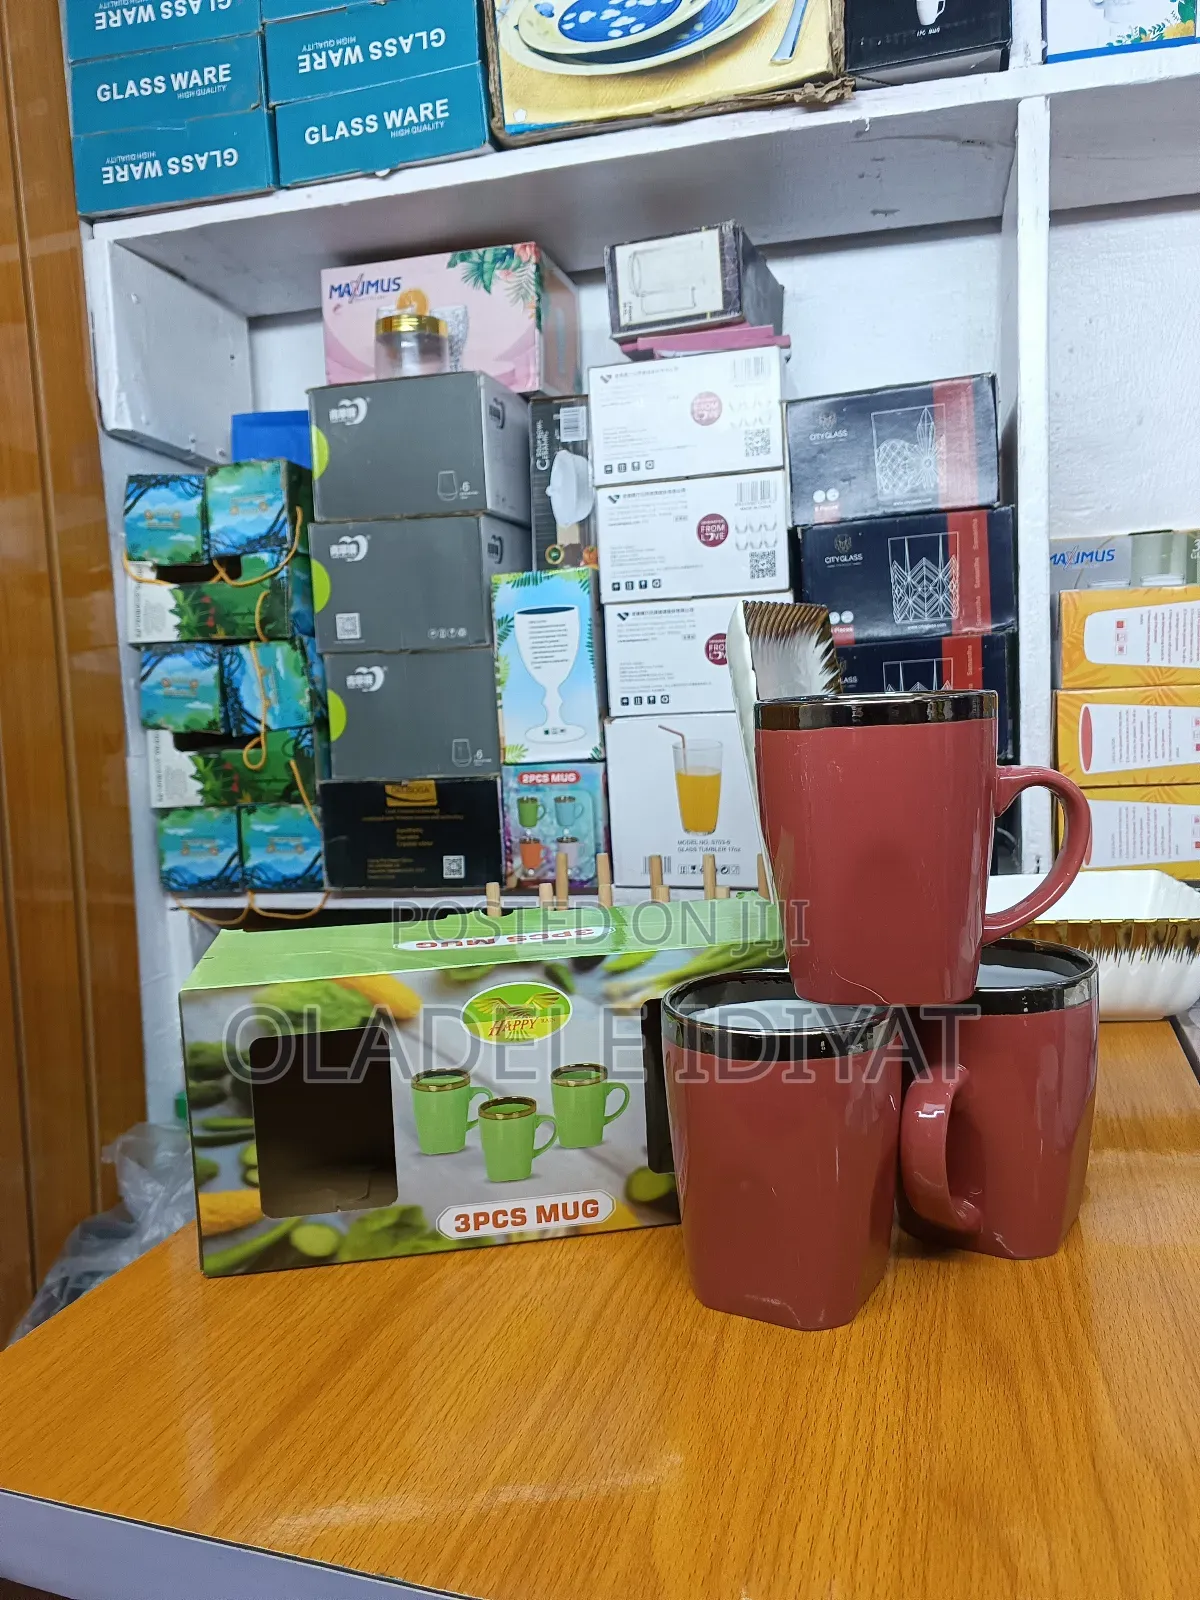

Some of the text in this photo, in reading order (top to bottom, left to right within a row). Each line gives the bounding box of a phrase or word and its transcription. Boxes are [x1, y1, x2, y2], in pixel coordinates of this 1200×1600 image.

[94, 4, 156, 31] WARE
[297, 28, 447, 74] GLASS WARE
[302, 35, 357, 53] HIGH QUALITY
[96, 63, 233, 103] GLASS WARE
[177, 84, 228, 101] HIGH QUALITY
[304, 98, 450, 145] GLASS WARE
[390, 120, 446, 139] HIGH QUALITY
[101, 147, 239, 185] GLASS WARE
[105, 150, 157, 165] HIGH QUALITY
[328, 272, 402, 304] MAXIMUS
[700, 524, 726, 534] FROM
[522, 772, 577, 784] 2PCS MUG
[415, 927, 595, 950] 3PCS MUG
[488, 1017, 538, 1037] HAPPY
[454, 1199, 599, 1233] 3PCS MUG
